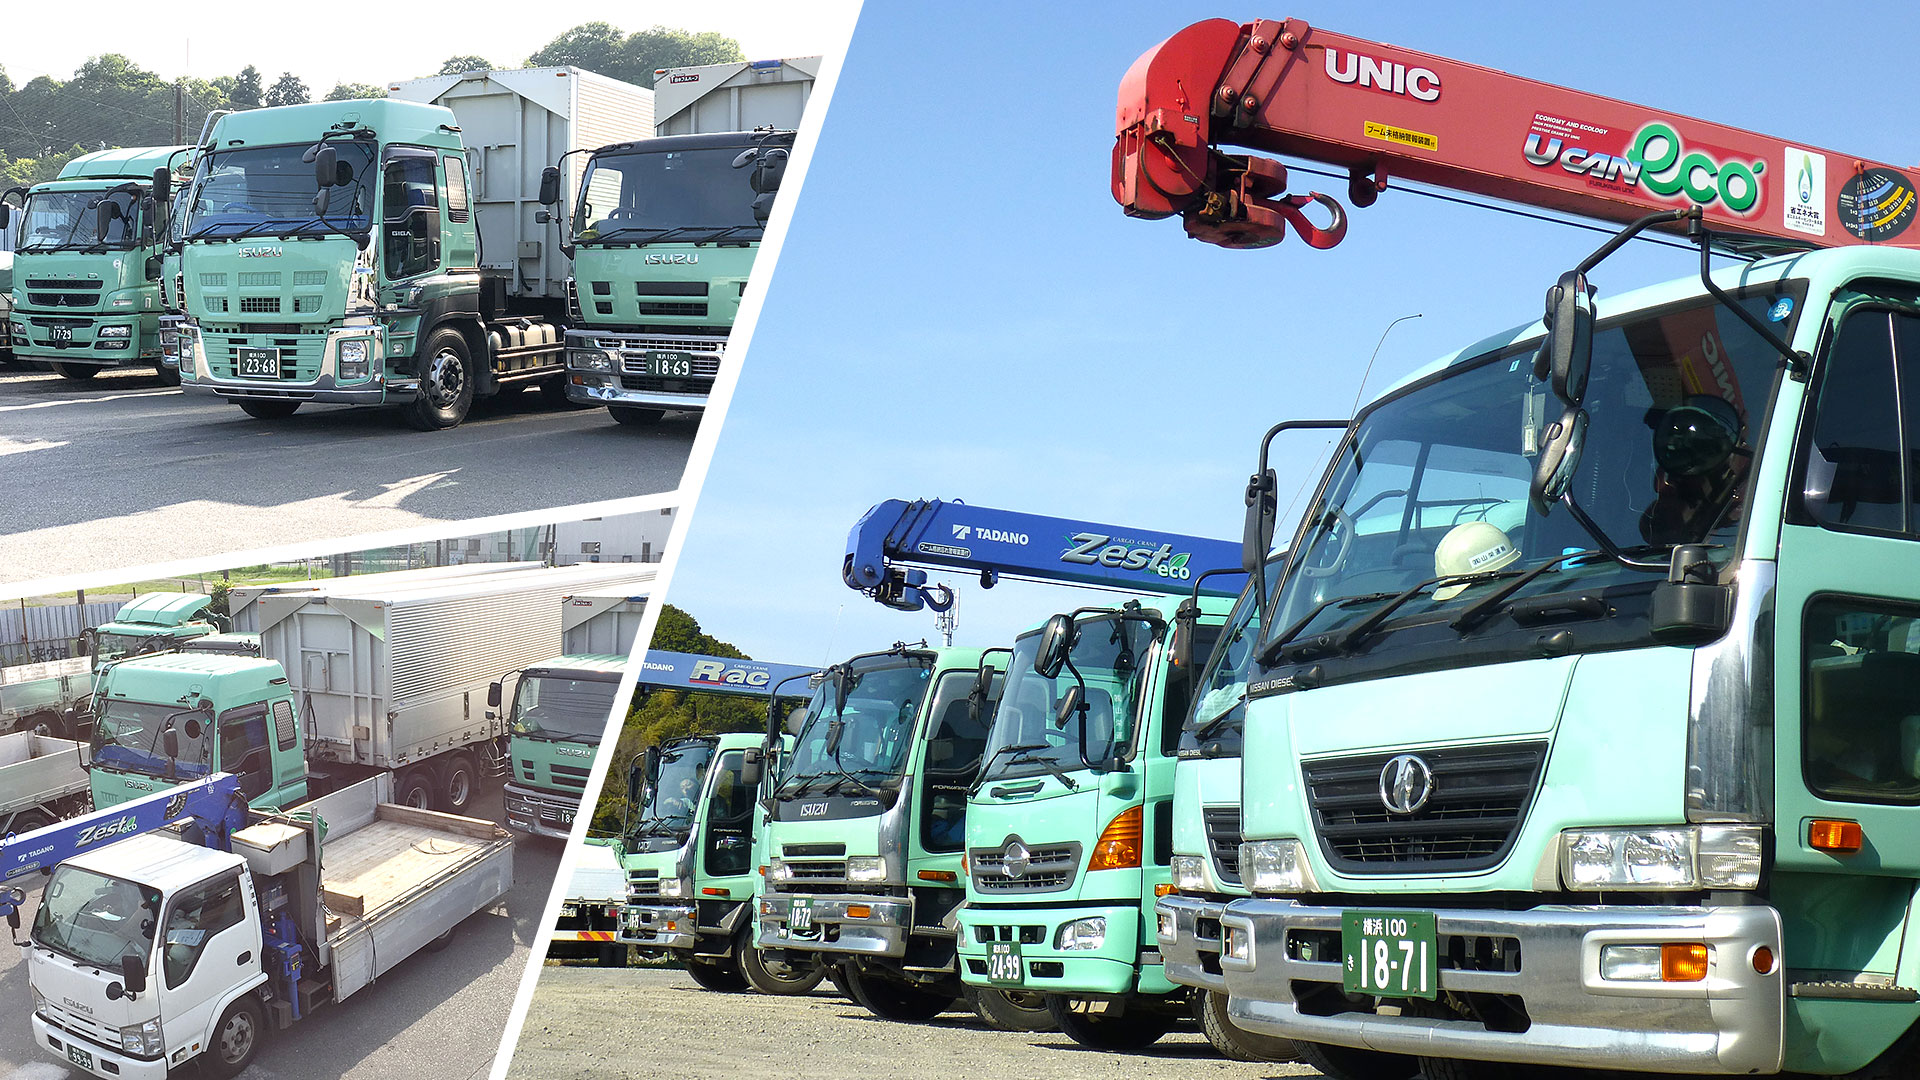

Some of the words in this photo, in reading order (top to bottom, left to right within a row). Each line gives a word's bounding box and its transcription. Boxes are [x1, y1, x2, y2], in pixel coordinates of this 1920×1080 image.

[1325, 47, 1441, 102] UNIC
[1535, 114, 1566, 125] ECONOMY
[1566, 121, 1580, 129] AND
[1580, 124, 1608, 135] ECOLOGY
[238, 246, 283, 258] ISUZU
[644, 253, 699, 265] ISUZU
[246, 358, 276, 373] 23-68
[655, 359, 690, 376] 18-69
[975, 527, 1029, 546] TADANO
[1112, 536, 1135, 545] CARGO
[1136, 540, 1158, 548] CRANE
[1060, 532, 1173, 571] Zest
[1157, 563, 1191, 580] eco
[643, 662, 675, 672] TADANO
[556, 747, 591, 758] ISUZU
[124, 778, 153, 792] ISUZU
[800, 802, 829, 817] ISUZU
[75, 815, 129, 849] Zest
[121, 823, 138, 834] eco
[28, 844, 55, 858] TADANO
[790, 907, 812, 928] 18-72
[991, 954, 1020, 980] 24-99
[1361, 938, 1427, 993] 18-71
[63, 996, 94, 1015] ISUZU
